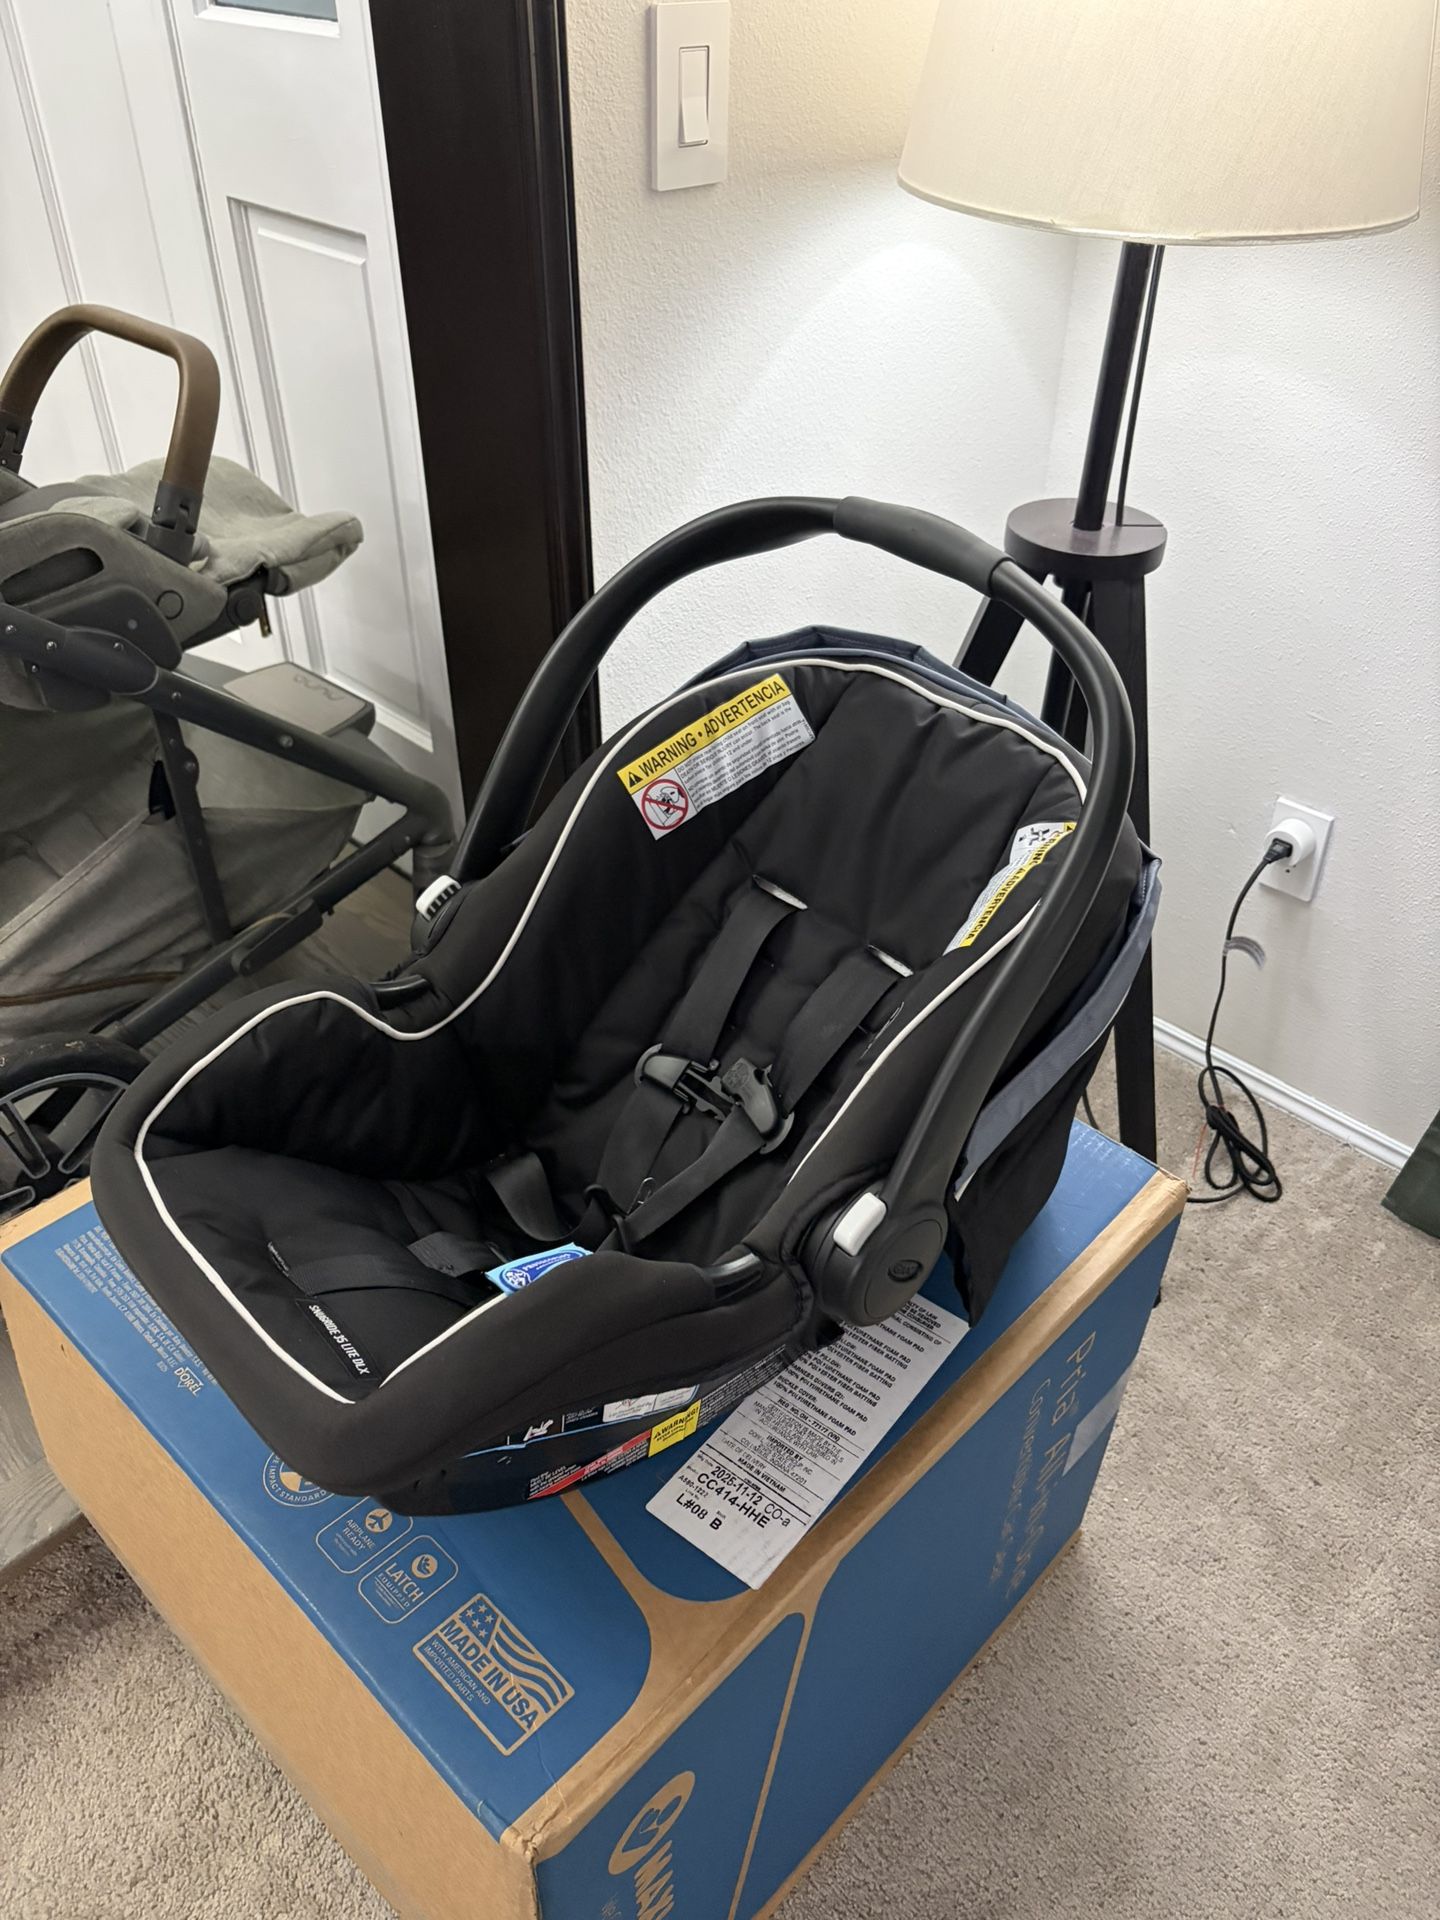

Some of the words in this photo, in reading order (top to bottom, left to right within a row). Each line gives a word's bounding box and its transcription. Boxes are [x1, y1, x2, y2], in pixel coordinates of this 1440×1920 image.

[638, 730, 698, 779] WARNING
[701, 678, 785, 737] ADVERTENCIA
[916, 1311, 941, 1329] REMOVED
[925, 1310, 938, 1321] LAW
[308, 1301, 340, 1337] SNUGRIDE
[340, 1340, 360, 1361] LITE
[351, 1355, 370, 1377] DLX
[881, 1343, 899, 1358] FOAM
[898, 1353, 911, 1365] PAD
[895, 1333, 912, 1347] FOAM
[912, 1342, 925, 1353] PAD
[867, 1361, 884, 1376] FOAM
[883, 1371, 896, 1383] PAD
[883, 1352, 908, 1370] BATTING
[173, 1365, 201, 1396] DOREL
[836, 1378, 854, 1394] FIBER
[852, 1389, 877, 1408] BATTING
[851, 1380, 869, 1395] FOAM
[868, 1390, 881, 1402] PAD
[868, 1370, 893, 1389] BATTING
[788, 1388, 829, 1419] POLYURETHANE
[825, 1413, 845, 1428] FOAM
[841, 1423, 858, 1438] PAD
[798, 1375, 840, 1405] POLYURETHANE
[838, 1400, 857, 1416] FOAM
[855, 1411, 868, 1423] PAD
[810, 1419, 829, 1434] 77177
[827, 1430, 841, 1443] (VN)
[765, 1434, 794, 1456] IMPORTED
[793, 1452, 803, 1462] BY
[269, 1465, 281, 1492] IMPACT
[279, 1489, 326, 1501] STANDARD
[736, 1456, 754, 1471] MADE
[752, 1467, 762, 1477] IN
[760, 1472, 786, 1493] VIETNAM
[789, 1470, 807, 1485] 47201
[675, 1492, 708, 1521] L#08
[709, 1516, 723, 1531] B
[695, 1471, 770, 1529] CC414-HHE
[710, 1464, 763, 1507] 2025-11-12
[762, 1501, 792, 1528] CO-a
[341, 1526, 366, 1552] READY
[345, 1517, 376, 1549] AIRPLANE
[377, 1571, 410, 1608] EQUIPPED
[384, 1560, 424, 1603] LATCH
[423, 1644, 456, 1680] IMPORTED
[453, 1678, 475, 1702] PARTS
[430, 1638, 448, 1657] WITH
[444, 1653, 478, 1691] AMERICAN
[474, 1687, 491, 1705] AND
[438, 1618, 492, 1674] MADE
[481, 1665, 510, 1693] IN
[498, 1685, 543, 1730] USA
